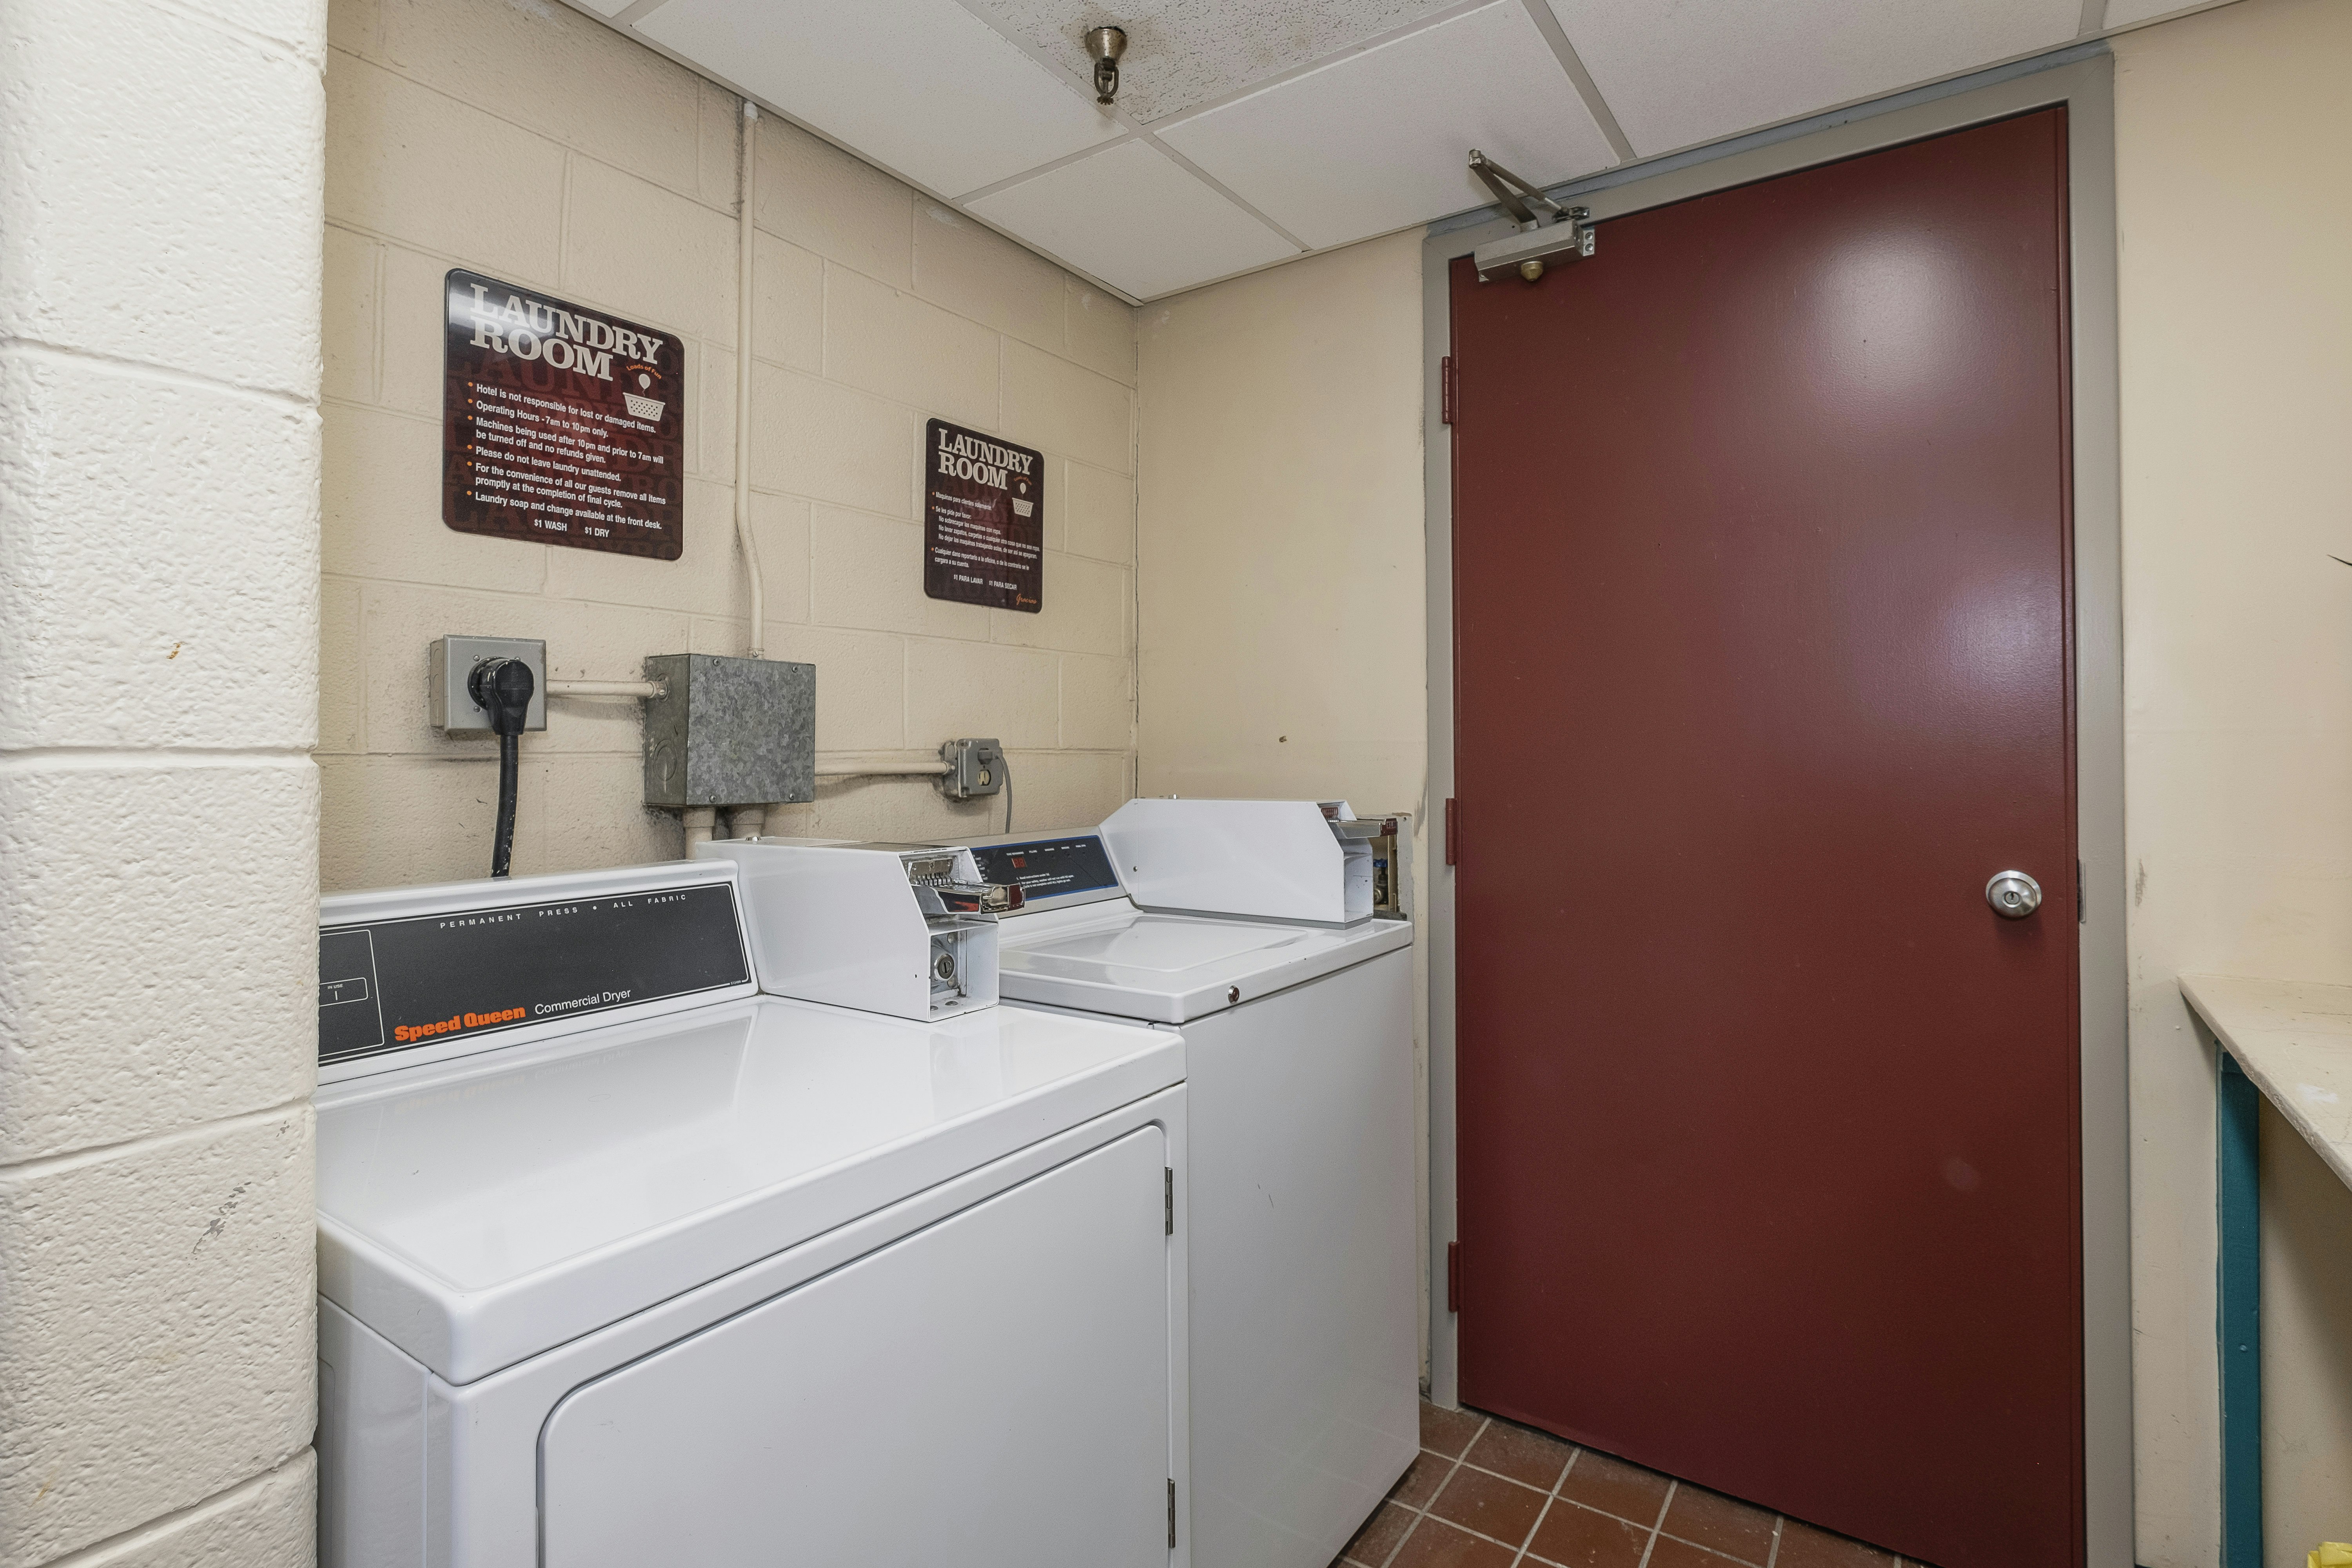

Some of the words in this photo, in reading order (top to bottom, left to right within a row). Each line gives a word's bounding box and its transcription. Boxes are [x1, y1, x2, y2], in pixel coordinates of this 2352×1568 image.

[471, 283, 663, 365] LAUNDRY
[470, 316, 613, 381] ROOM
[651, 369, 662, 379] Fun
[476, 400, 515, 418] Operating
[517, 409, 539, 422] Hours
[562, 420, 570, 428] to
[592, 428, 608, 439] only.
[477, 383, 497, 396] Hotel
[500, 388, 506, 398] is
[509, 393, 521, 402] not
[524, 396, 566, 412] responsible
[568, 405, 579, 415] for
[580, 408, 593, 419] lost
[604, 414, 635, 428] damaged
[637, 421, 656, 433] items.
[476, 417, 514, 432] Machines
[515, 425, 536, 439] being
[539, 432, 557, 442] used
[559, 436, 575, 445] after
[597, 445, 610, 453] and
[612, 447, 628, 456] prior
[629, 450, 637, 458] to
[653, 456, 664, 464] will
[476, 429, 486, 439] be
[488, 432, 514, 445] turned
[516, 438, 527, 447] off
[528, 442, 543, 450] and
[557, 447, 584, 459] refunds
[586, 452, 606, 463] given.
[938, 428, 1033, 475] LAUNDRY
[476, 446, 502, 459] Please
[504, 452, 515, 461] do
[517, 456, 529, 464] not
[532, 457, 551, 468] leave
[553, 461, 579, 475] laundry
[581, 468, 621, 481] unattended.
[938, 451, 1008, 490] ROOM
[475, 477, 510, 491] promptly
[512, 483, 520, 491] at
[522, 483, 534, 493] the
[536, 487, 576, 500] completion
[578, 494, 586, 502] of
[587, 494, 602, 505] final
[603, 499, 622, 508] cycle.
[476, 463, 490, 473] For
[491, 466, 504, 475] the
[506, 470, 553, 485] convenience
[555, 478, 563, 486] of
[564, 479, 573, 488] all
[588, 485, 612, 495] guests
[613, 489, 638, 499] remove
[648, 494, 666, 505] items
[475, 492, 508, 507] Laundry
[510, 499, 529, 510] soap
[531, 503, 545, 511] and
[547, 504, 573, 517] change
[575, 510, 605, 520] available
[615, 515, 626, 524] the
[627, 517, 643, 526] front
[645, 519, 662, 529] desk.
[534, 519, 542, 528] $1
[544, 520, 567, 532] WASH
[585, 526, 592, 535] $1
[595, 528, 610, 537] DRY
[1016, 593, 1037, 605] Gracias
[440, 914, 521, 929] PERMANENT
[539, 907, 577, 917] PRESS
[648, 895, 686, 904] FABRIC
[535, 994, 600, 1014] Commercial
[603, 989, 631, 1002] Dryer
[394, 1016, 461, 1042] Speed
[464, 1007, 526, 1027] Queen
